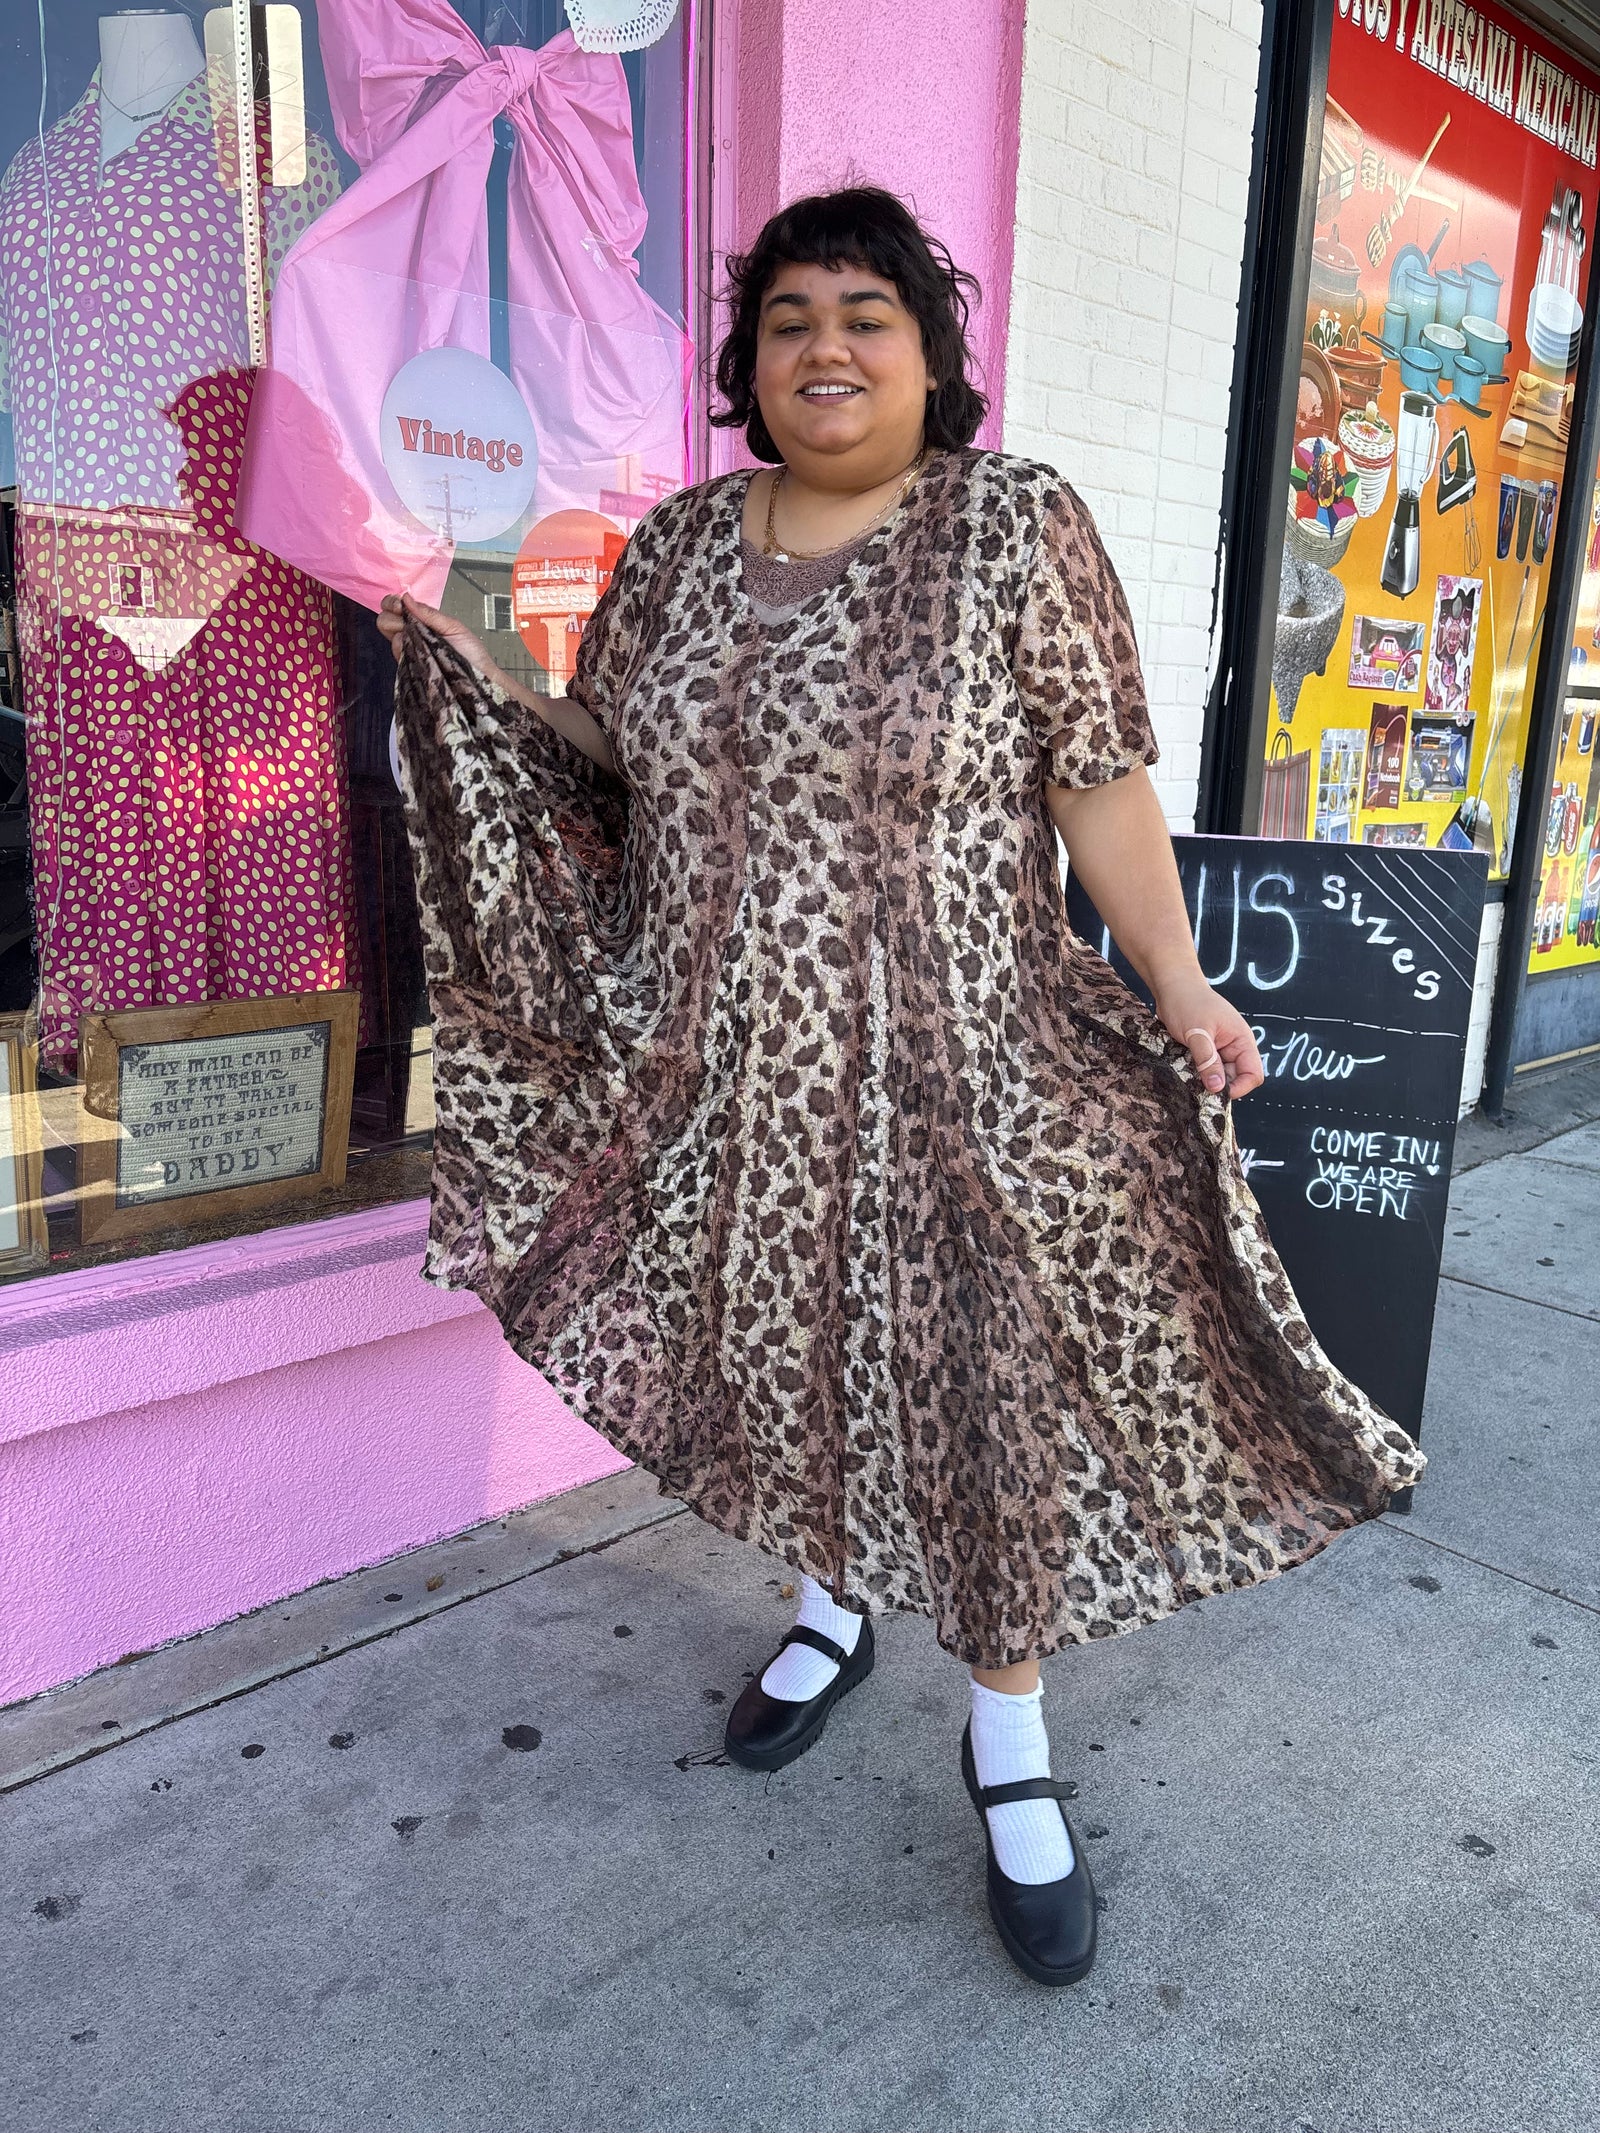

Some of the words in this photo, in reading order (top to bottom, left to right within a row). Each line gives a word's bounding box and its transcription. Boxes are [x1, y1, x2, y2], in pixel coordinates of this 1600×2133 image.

[1410, 0, 1516, 119] ARTESANIA
[1514, 45, 1600, 170] MEXICANA
[396, 415, 524, 473] Vintage
[521, 583, 602, 608] Accesso
[1387, 757, 1400, 769] 100
[188, 1055, 234, 1074] MAN
[241, 1049, 282, 1067] CAN
[290, 1045, 314, 1061] BE
[150, 1097, 195, 1116] BUT
[203, 1093, 226, 1110] IT
[237, 1083, 298, 1104] TAKES
[130, 1112, 229, 1139] SOMEONE
[234, 1100, 314, 1123] SPECIAL
[188, 1133, 213, 1151] TO
[220, 1129, 245, 1146] BE
[250, 1126, 263, 1141] A
[1310, 1126, 1386, 1163] COME
[1390, 1135, 1440, 1164] IN!
[1317, 1158, 1360, 1184] WE
[1361, 1165, 1416, 1190] ARE
[1306, 1177, 1409, 1220] OPEN
